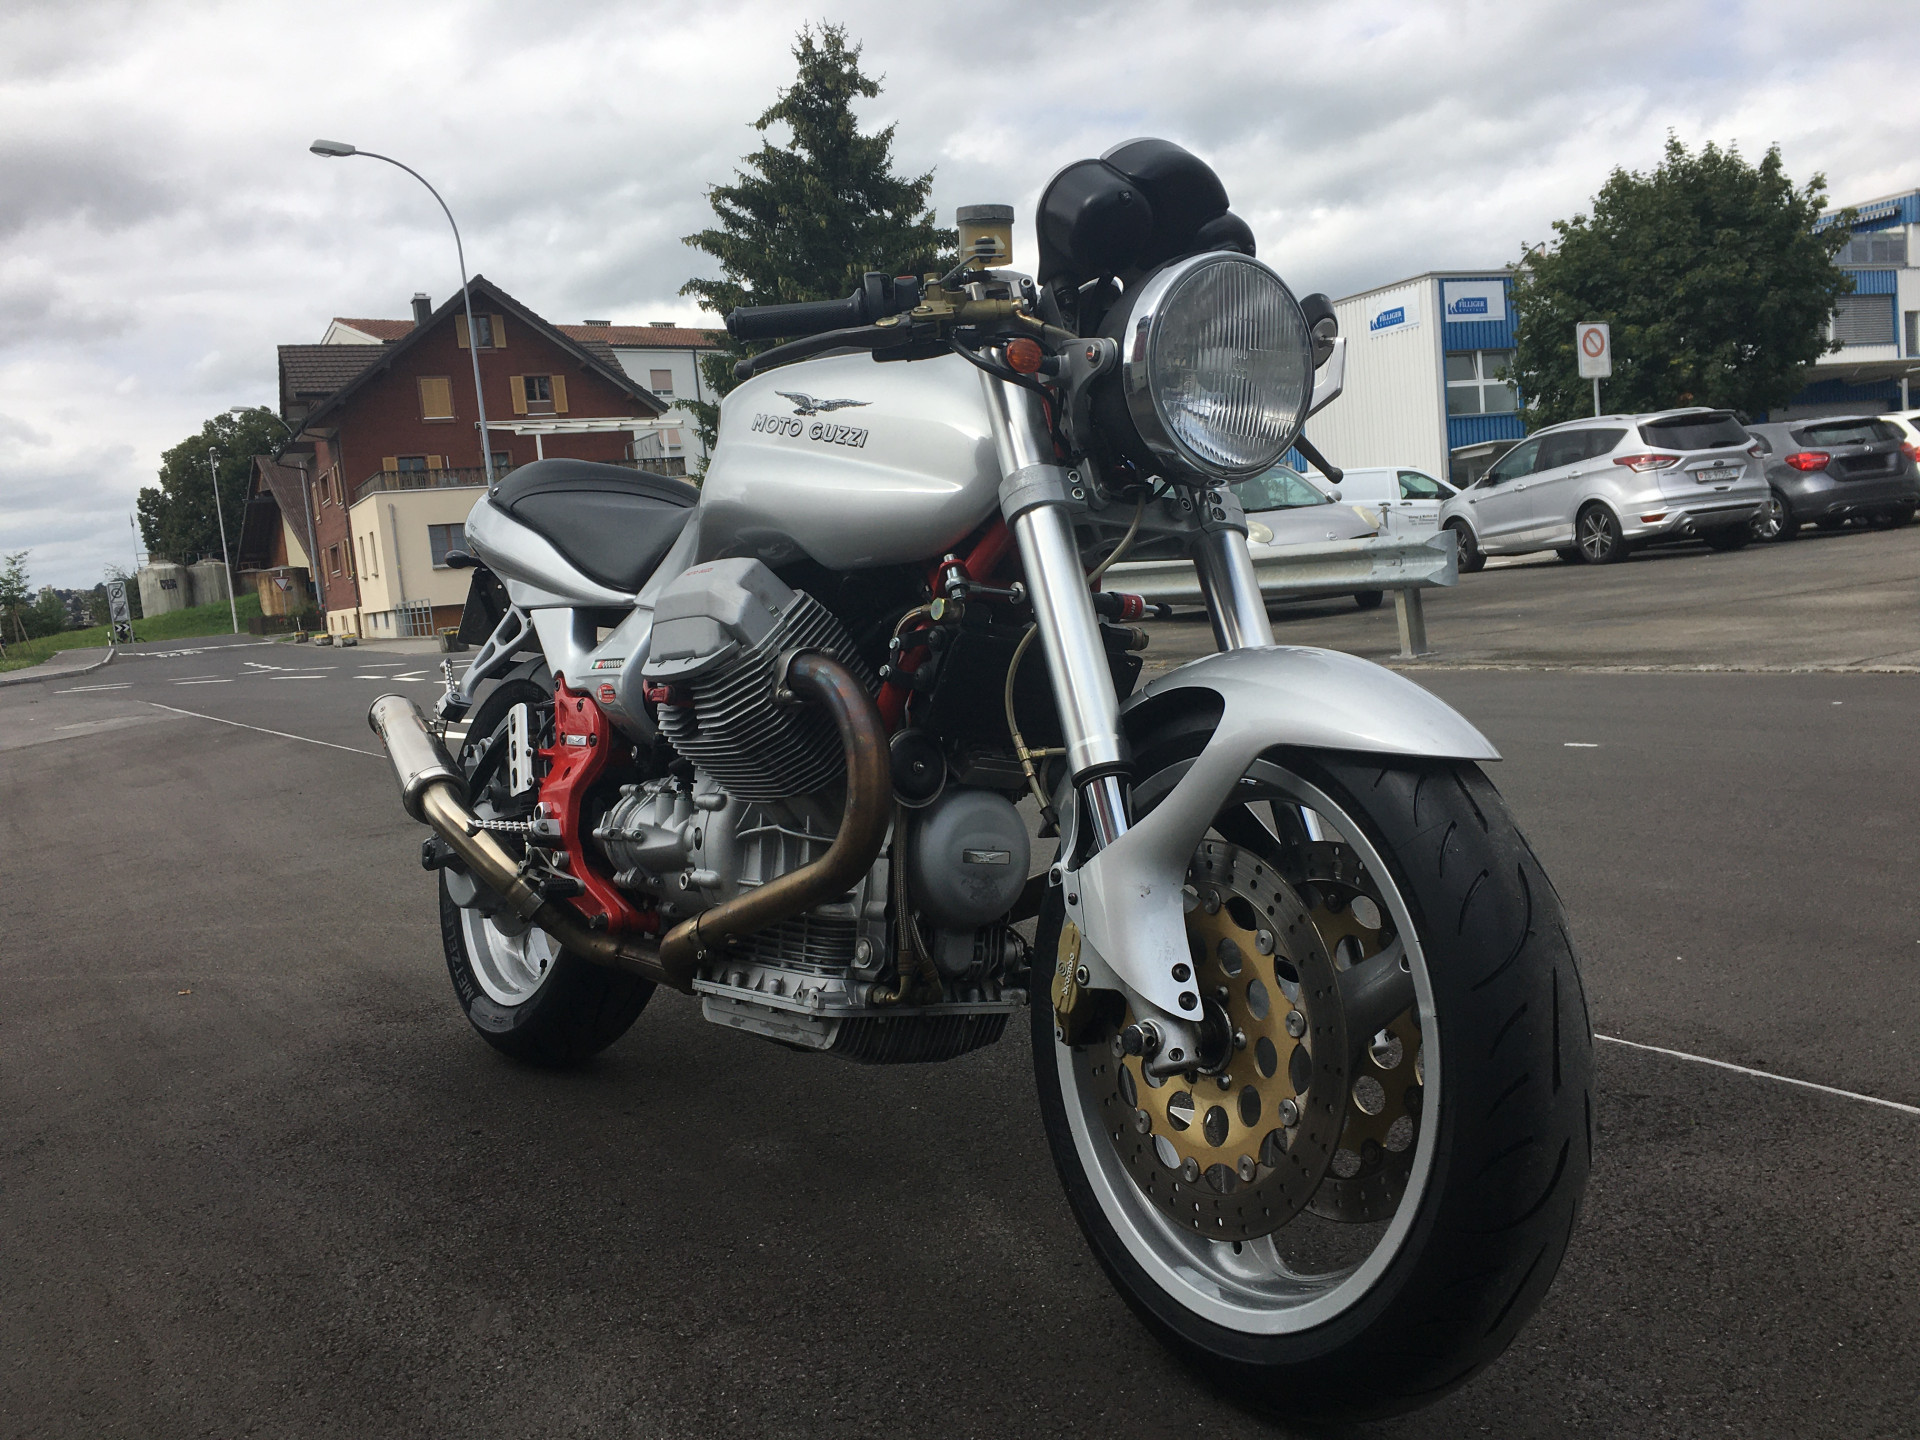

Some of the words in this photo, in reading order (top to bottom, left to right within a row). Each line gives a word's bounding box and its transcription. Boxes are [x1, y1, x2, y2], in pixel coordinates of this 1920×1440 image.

[1459, 300, 1485, 308] FILLIGER
[1379, 311, 1402, 322] FILLIGER
[751, 413, 803, 438] MOTO
[809, 421, 869, 448] GUZZI
[1062, 953, 1075, 995] brembo
